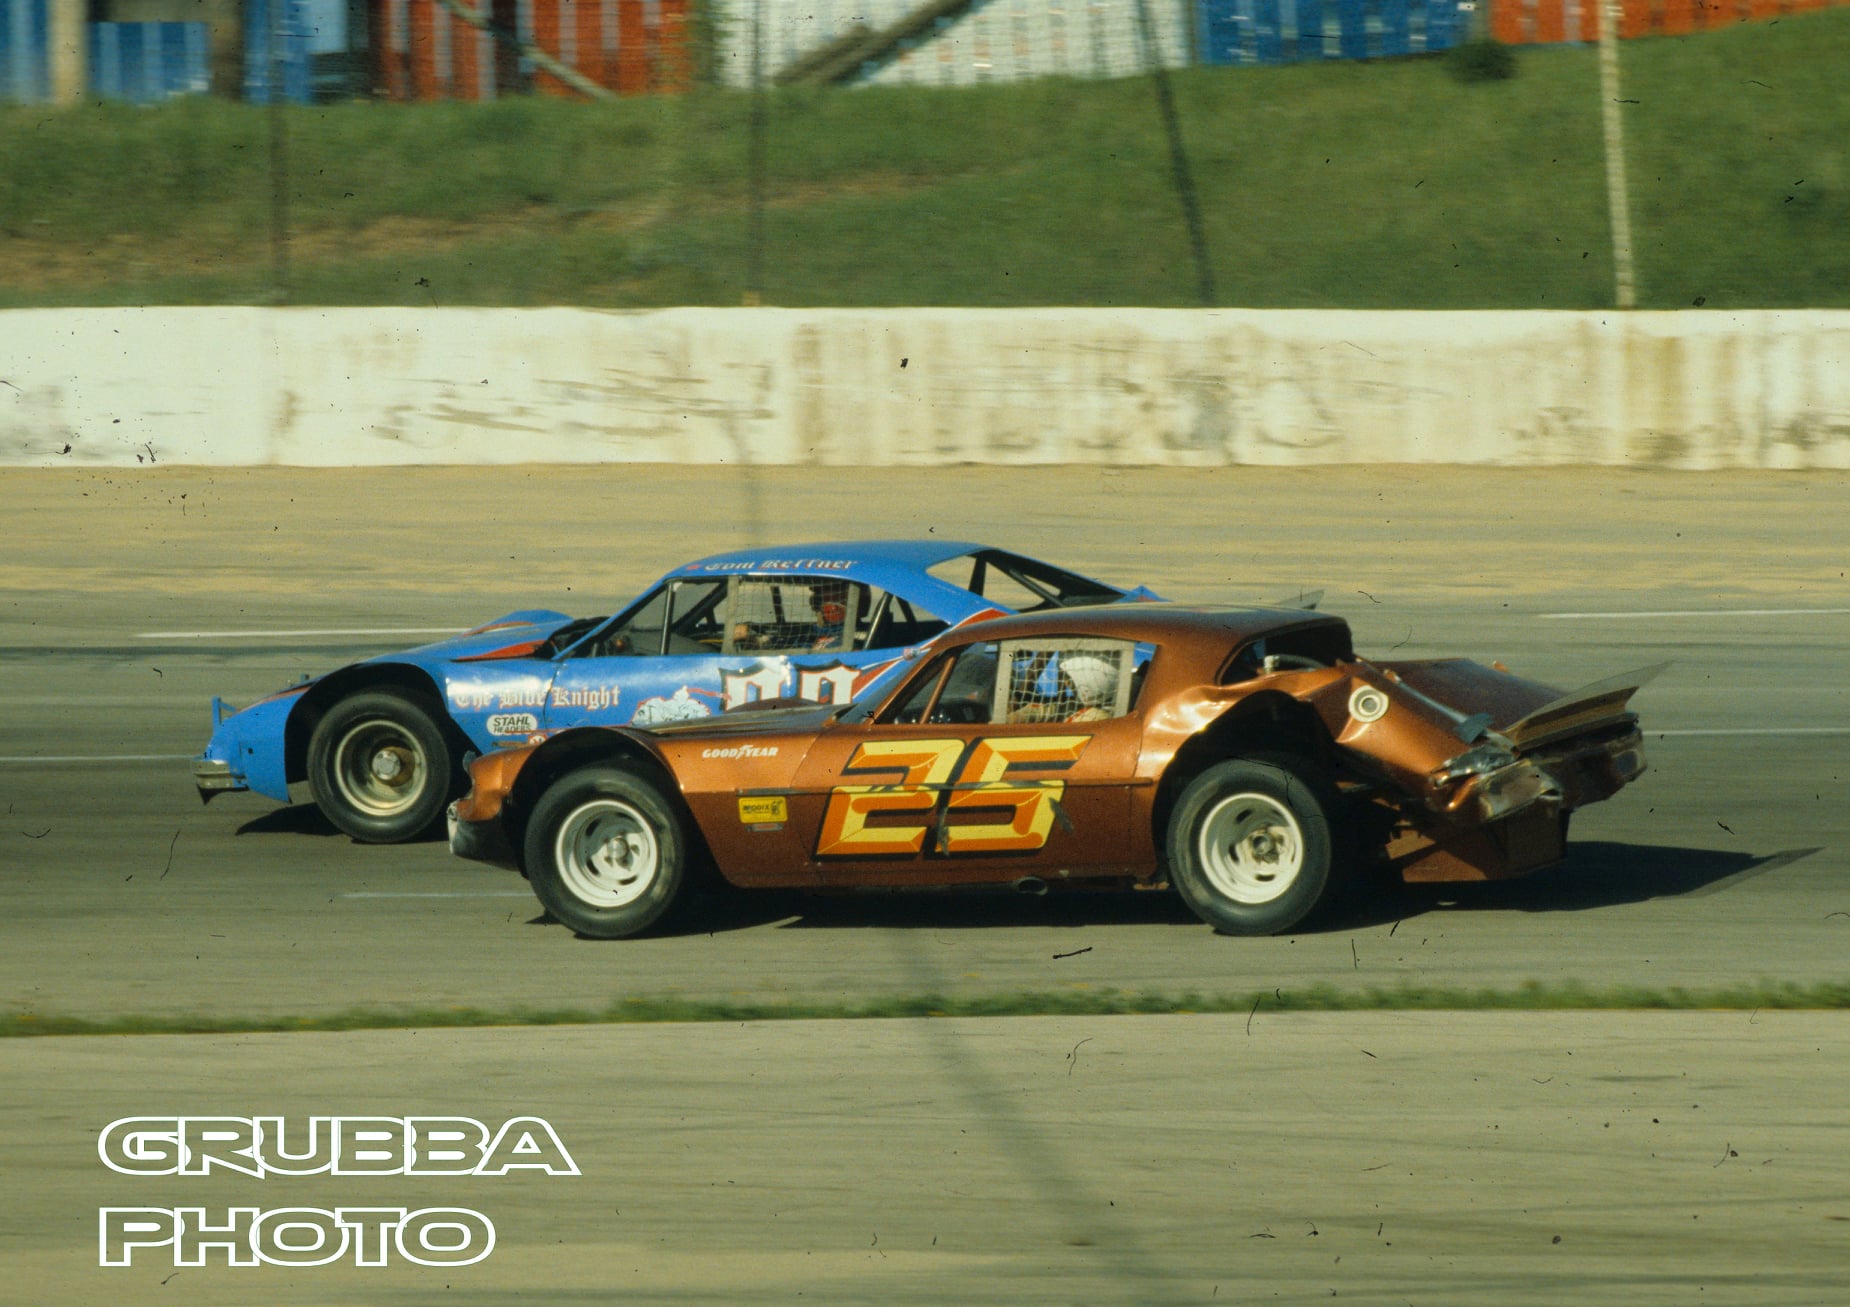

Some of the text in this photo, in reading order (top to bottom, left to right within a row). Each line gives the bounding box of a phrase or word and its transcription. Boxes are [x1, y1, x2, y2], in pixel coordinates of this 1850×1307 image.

[551, 684, 622, 711] Knight
[493, 716, 530, 726] STAHL
[702, 744, 779, 760] GOODYEAR
[810, 735, 1095, 862] 25
